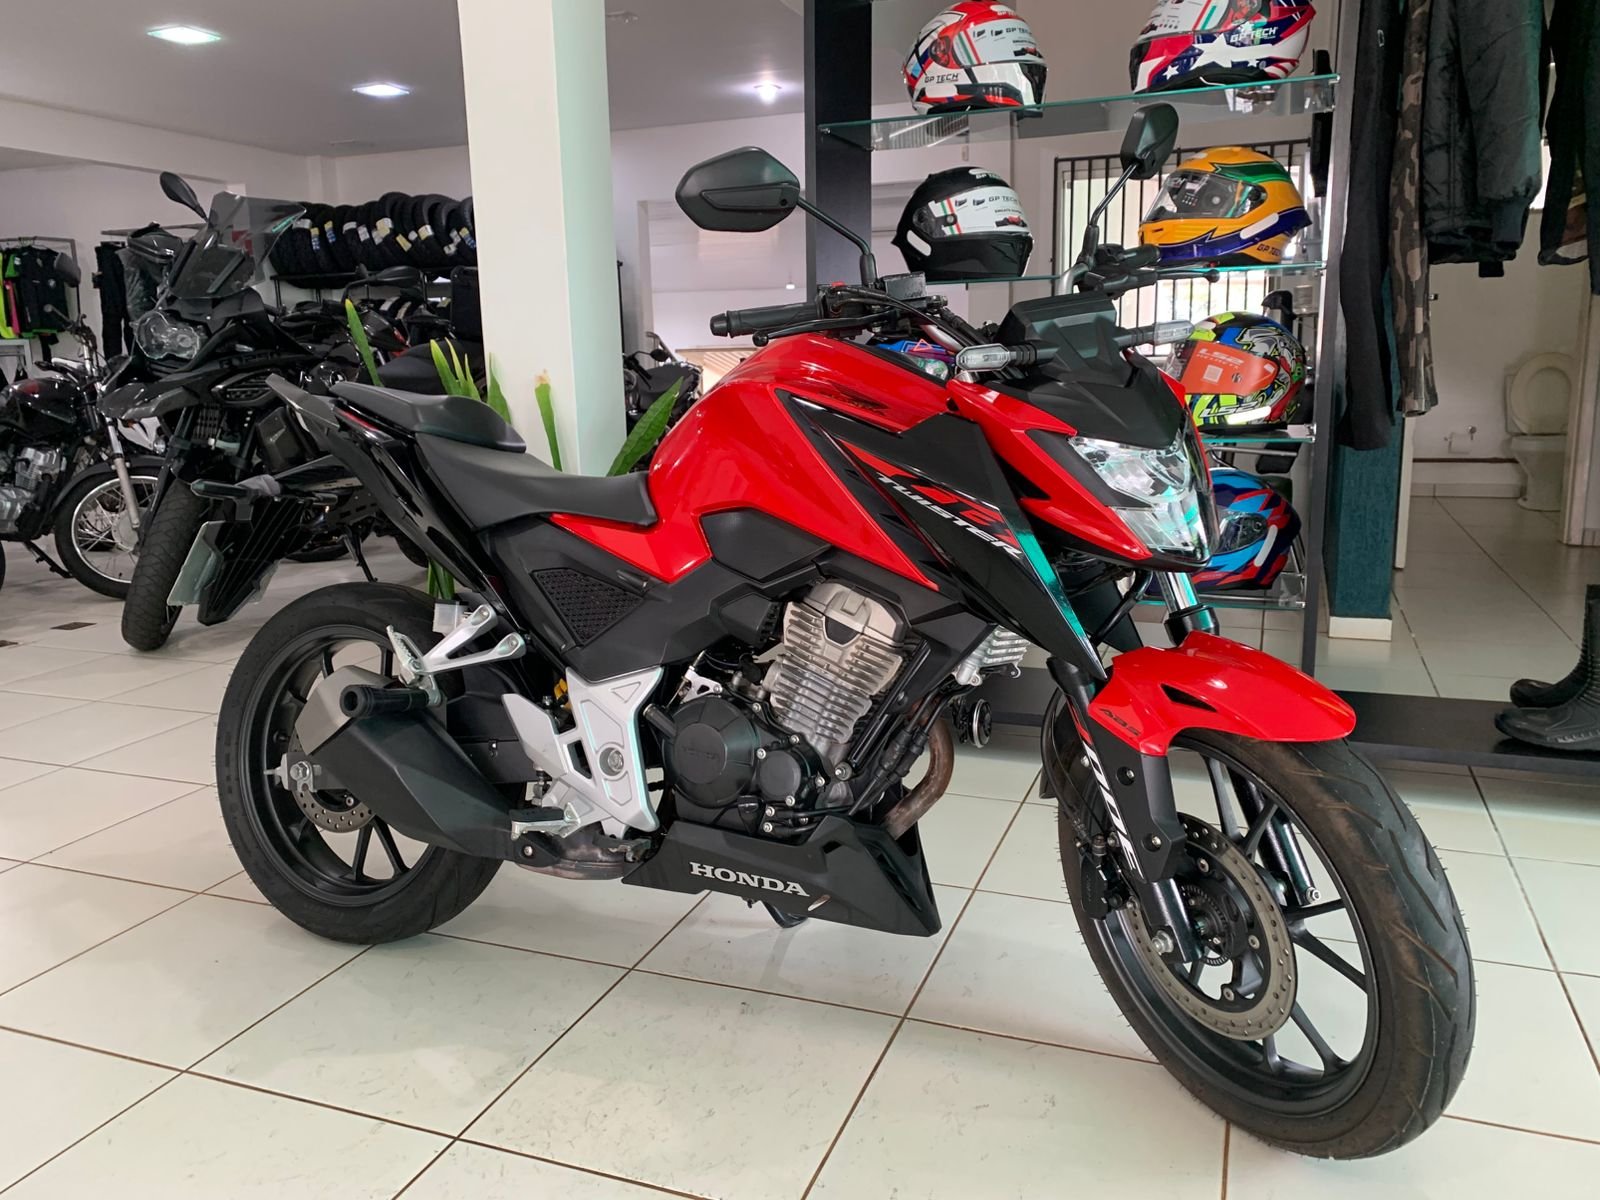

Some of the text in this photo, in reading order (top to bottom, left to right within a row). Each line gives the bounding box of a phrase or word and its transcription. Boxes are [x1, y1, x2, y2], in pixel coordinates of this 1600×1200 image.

[924, 72, 960, 84] GP TECH
[1198, 400, 1260, 418] LS2
[875, 470, 1023, 560] TWISTER
[1099, 707, 1142, 737] ABS
[689, 861, 811, 897] HONDA
